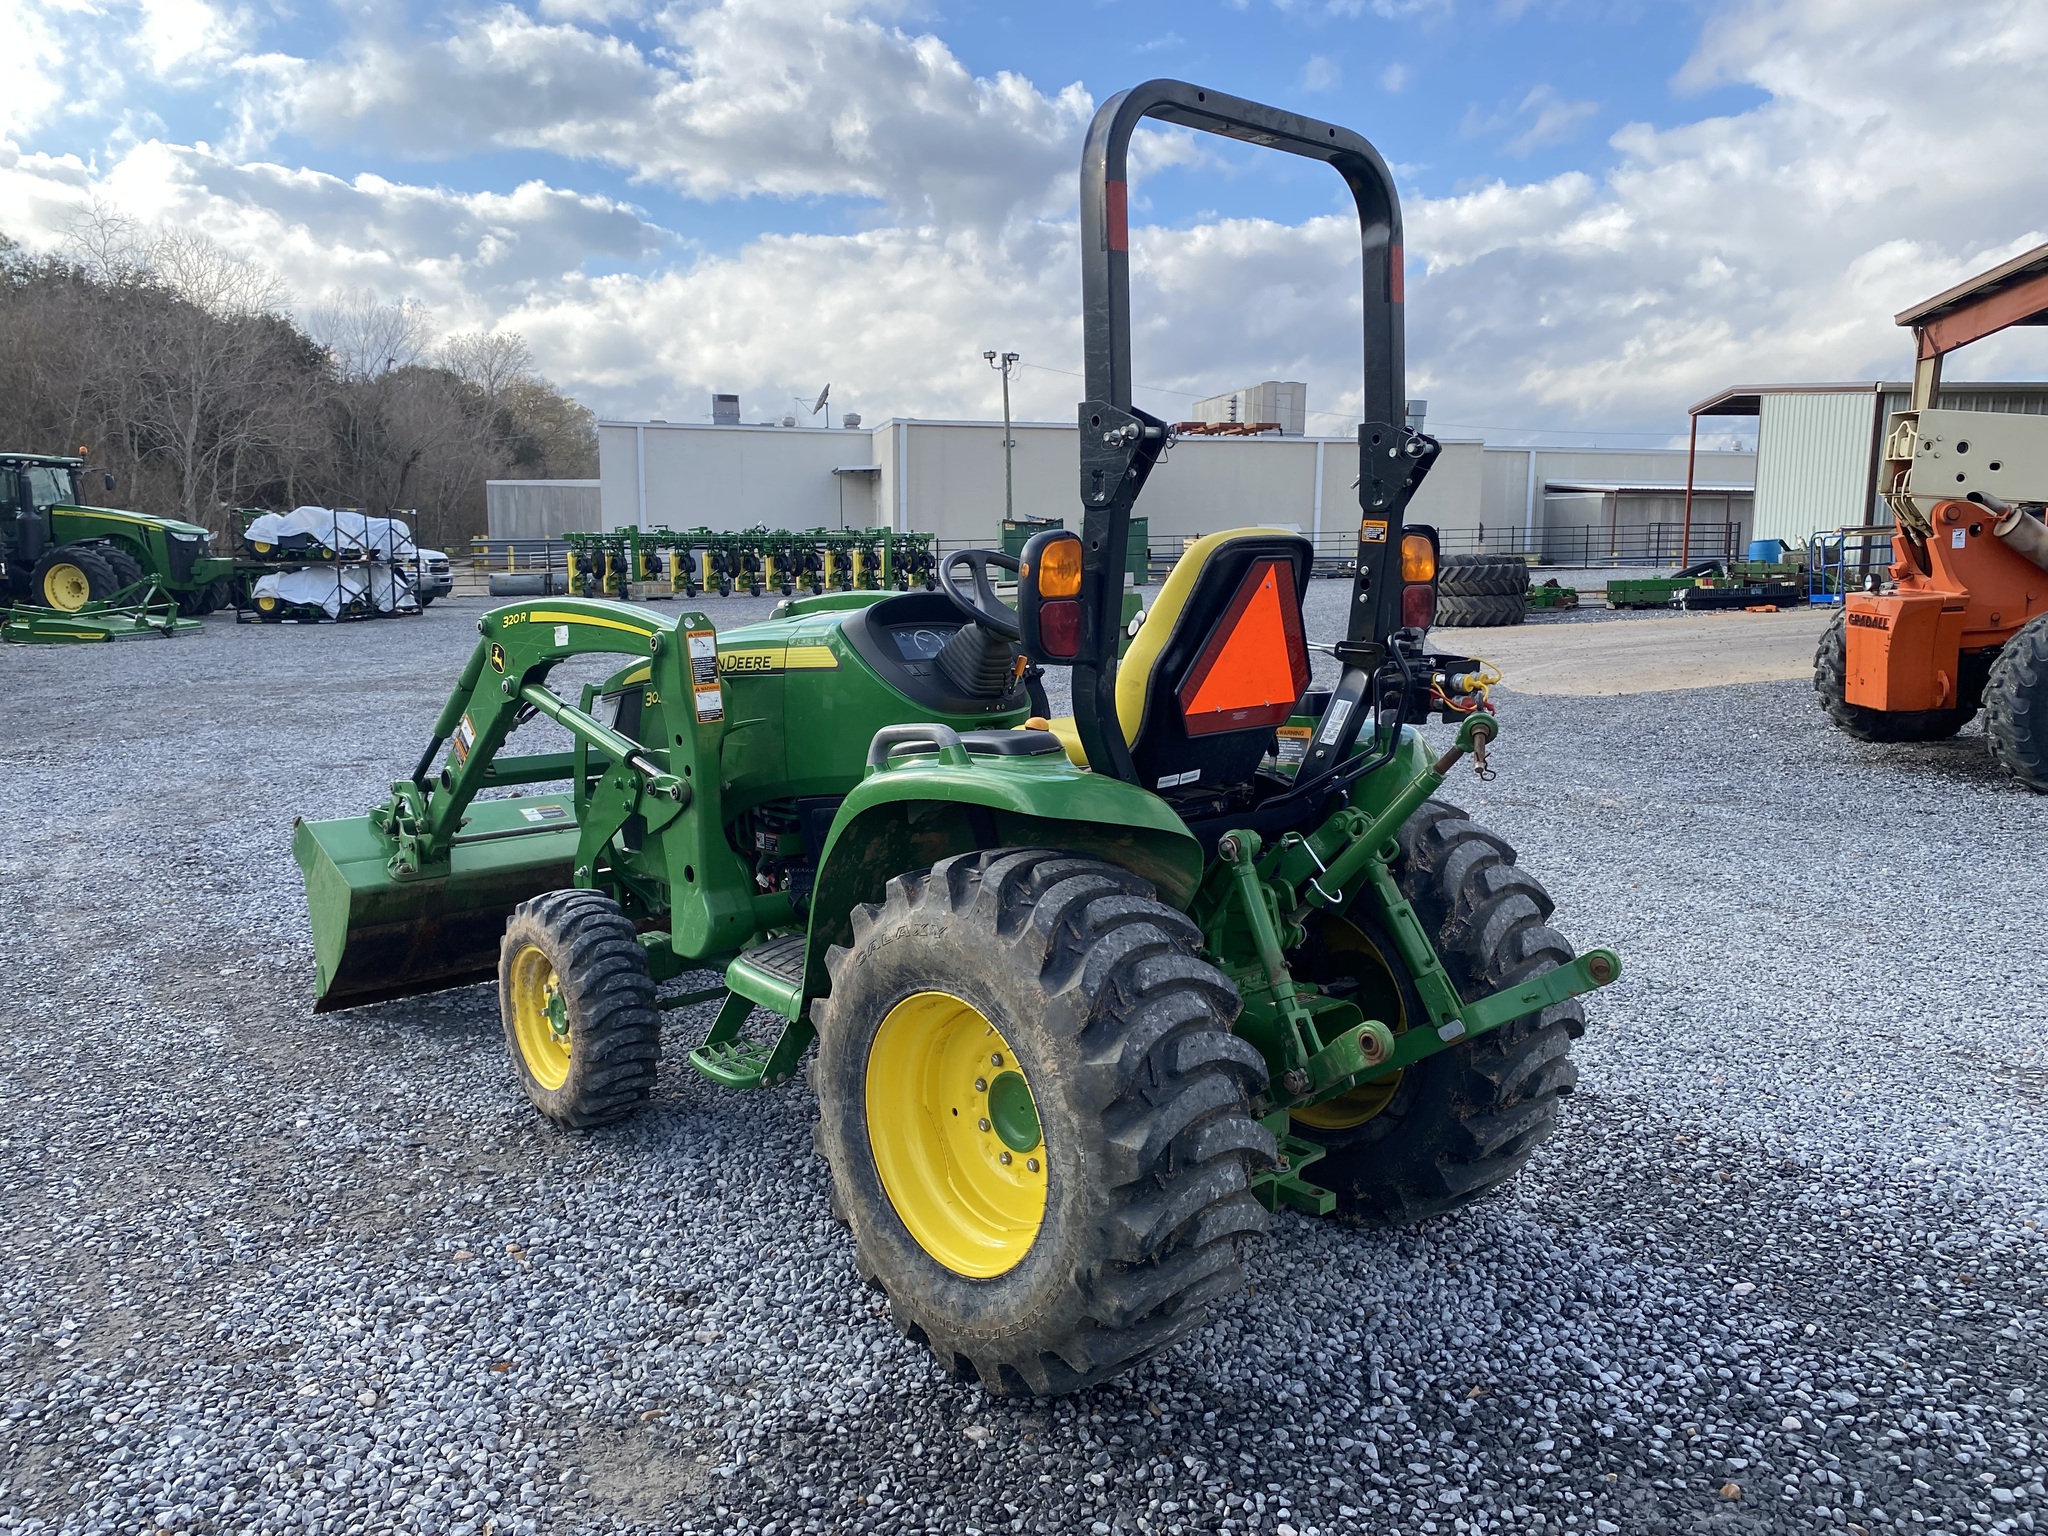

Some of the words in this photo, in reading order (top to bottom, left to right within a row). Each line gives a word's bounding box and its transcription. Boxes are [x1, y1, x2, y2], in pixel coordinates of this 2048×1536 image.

[502, 613, 520, 629] 320
[520, 611, 527, 622] R
[1848, 613, 1890, 631] GRADALL
[726, 655, 772, 671] DEERE
[645, 691, 662, 707] 30
[855, 922, 948, 968] GALAXY
